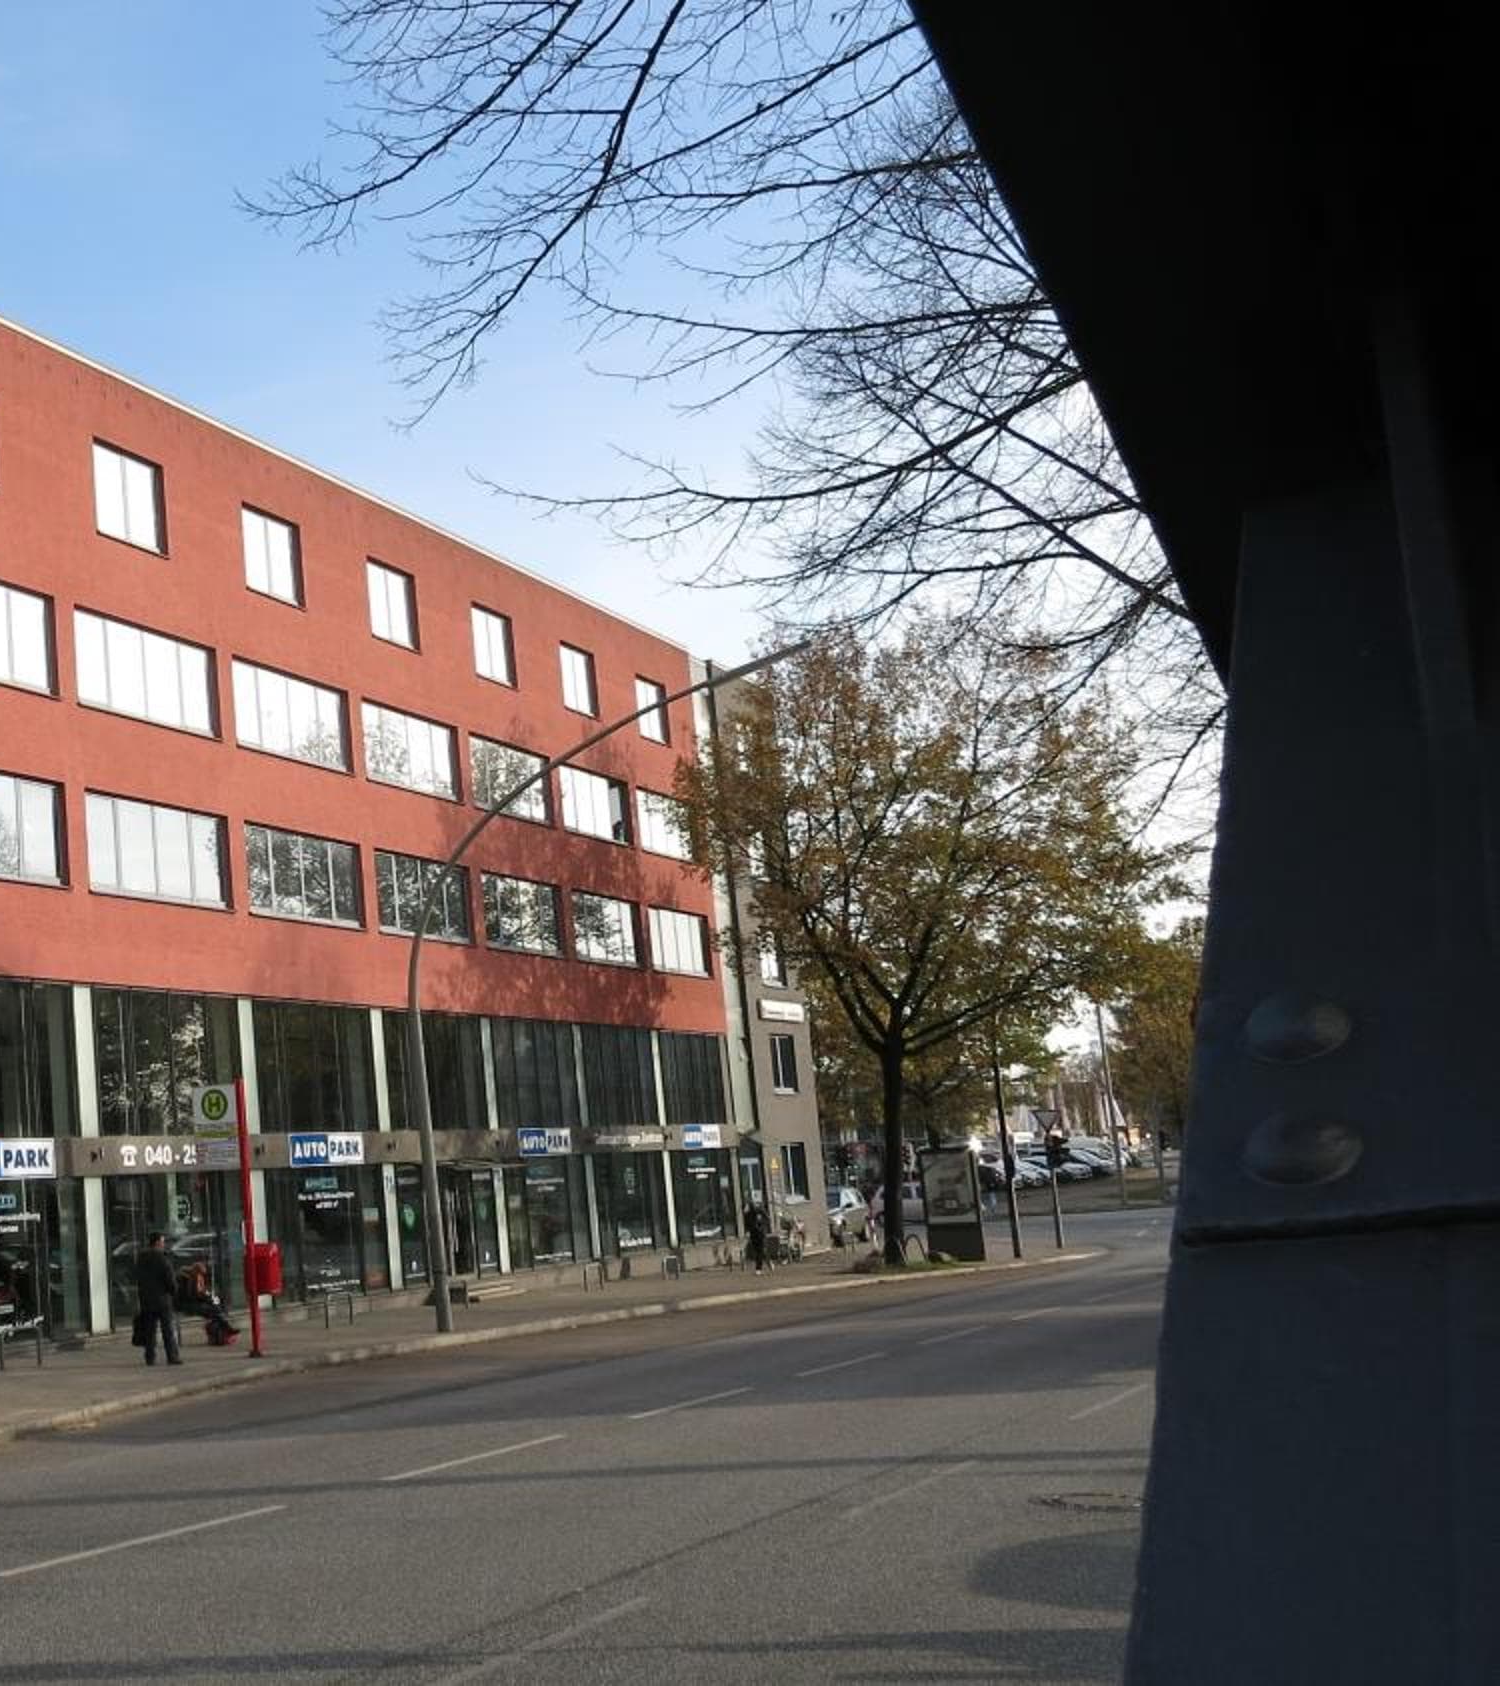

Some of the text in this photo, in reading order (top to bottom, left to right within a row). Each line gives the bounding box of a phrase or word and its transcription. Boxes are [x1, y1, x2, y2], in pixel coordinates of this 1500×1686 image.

[4, 1148, 49, 1169] PARK
[144, 1144, 173, 1166] 040
[293, 1140, 360, 1159] AUTO PARK
